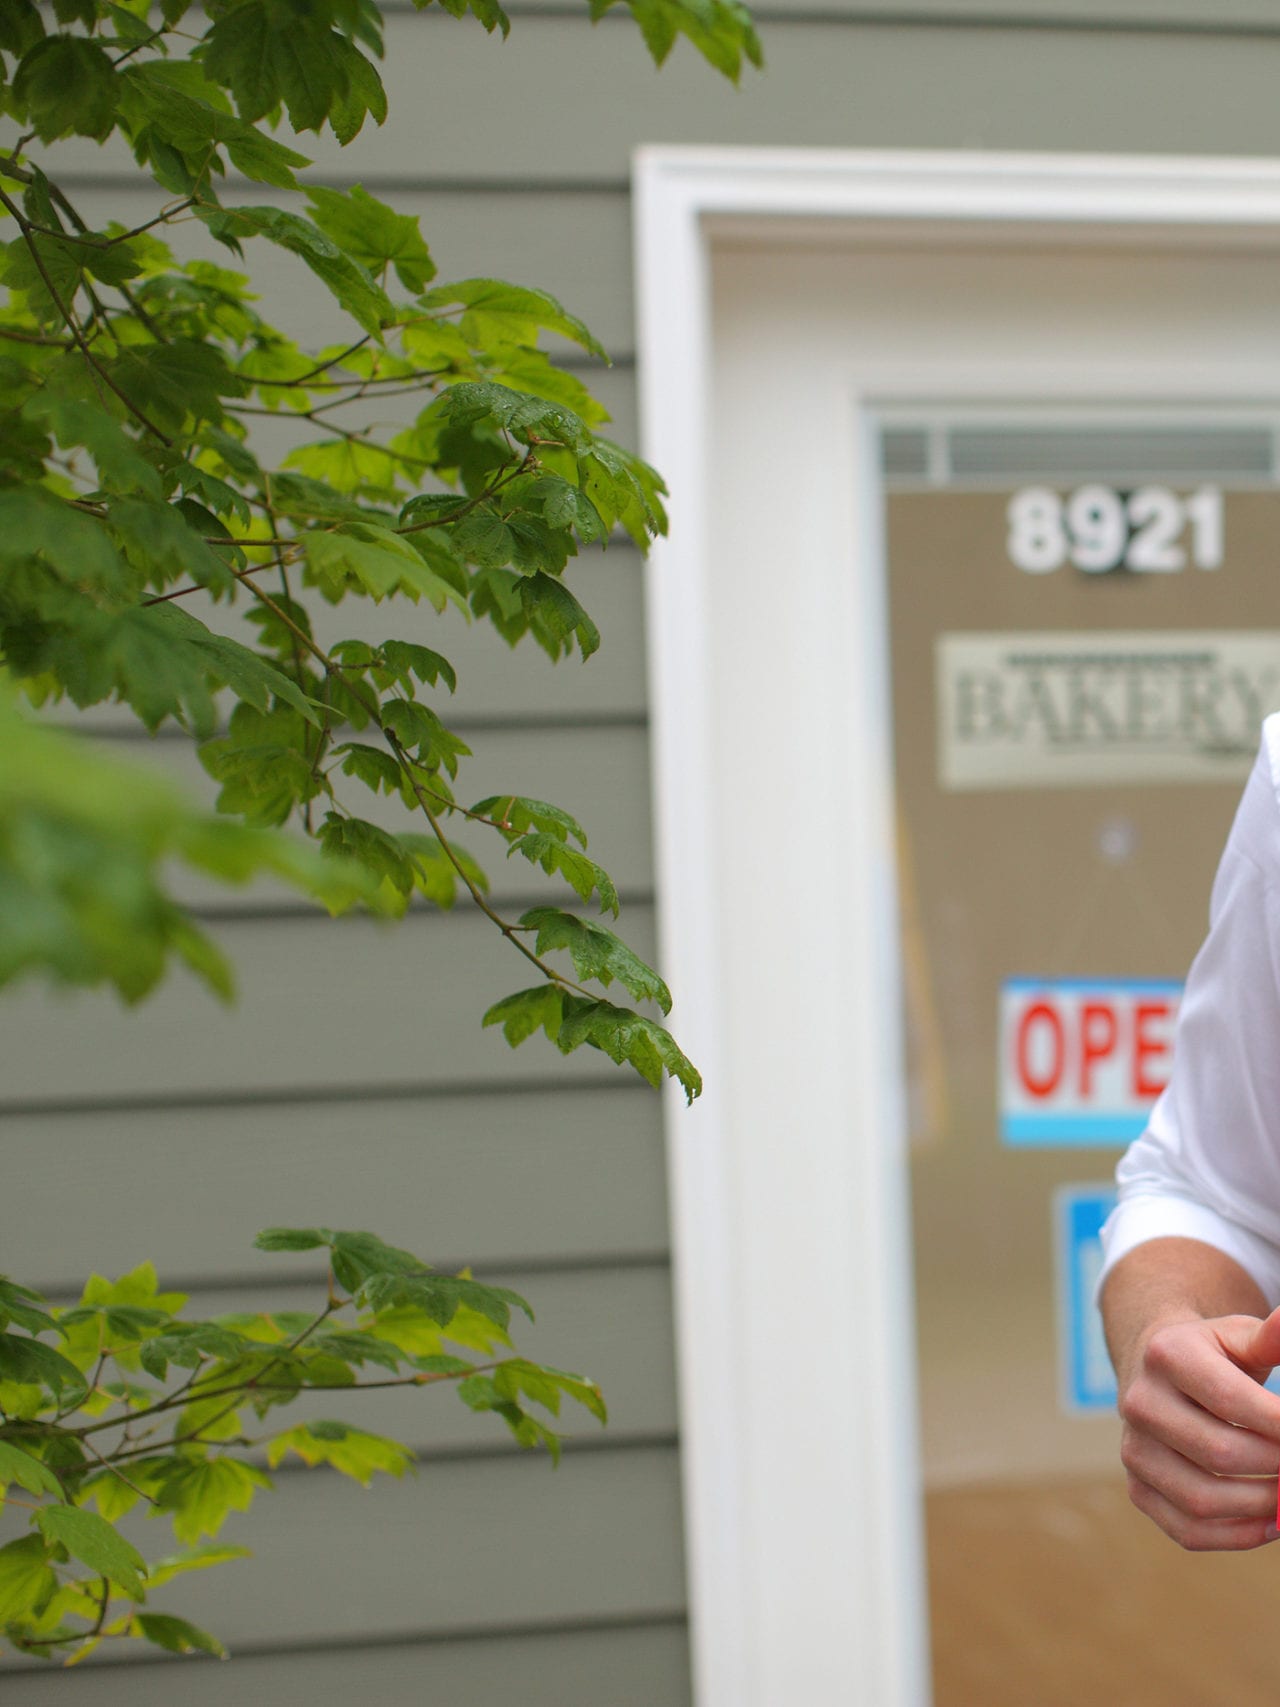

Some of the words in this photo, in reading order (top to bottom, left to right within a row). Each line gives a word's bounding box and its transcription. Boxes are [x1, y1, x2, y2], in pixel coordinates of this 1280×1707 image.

[1006, 486, 1225, 574] 8921
[955, 666, 1280, 744] BAKERY
[1015, 1000, 1171, 1099] OPE
